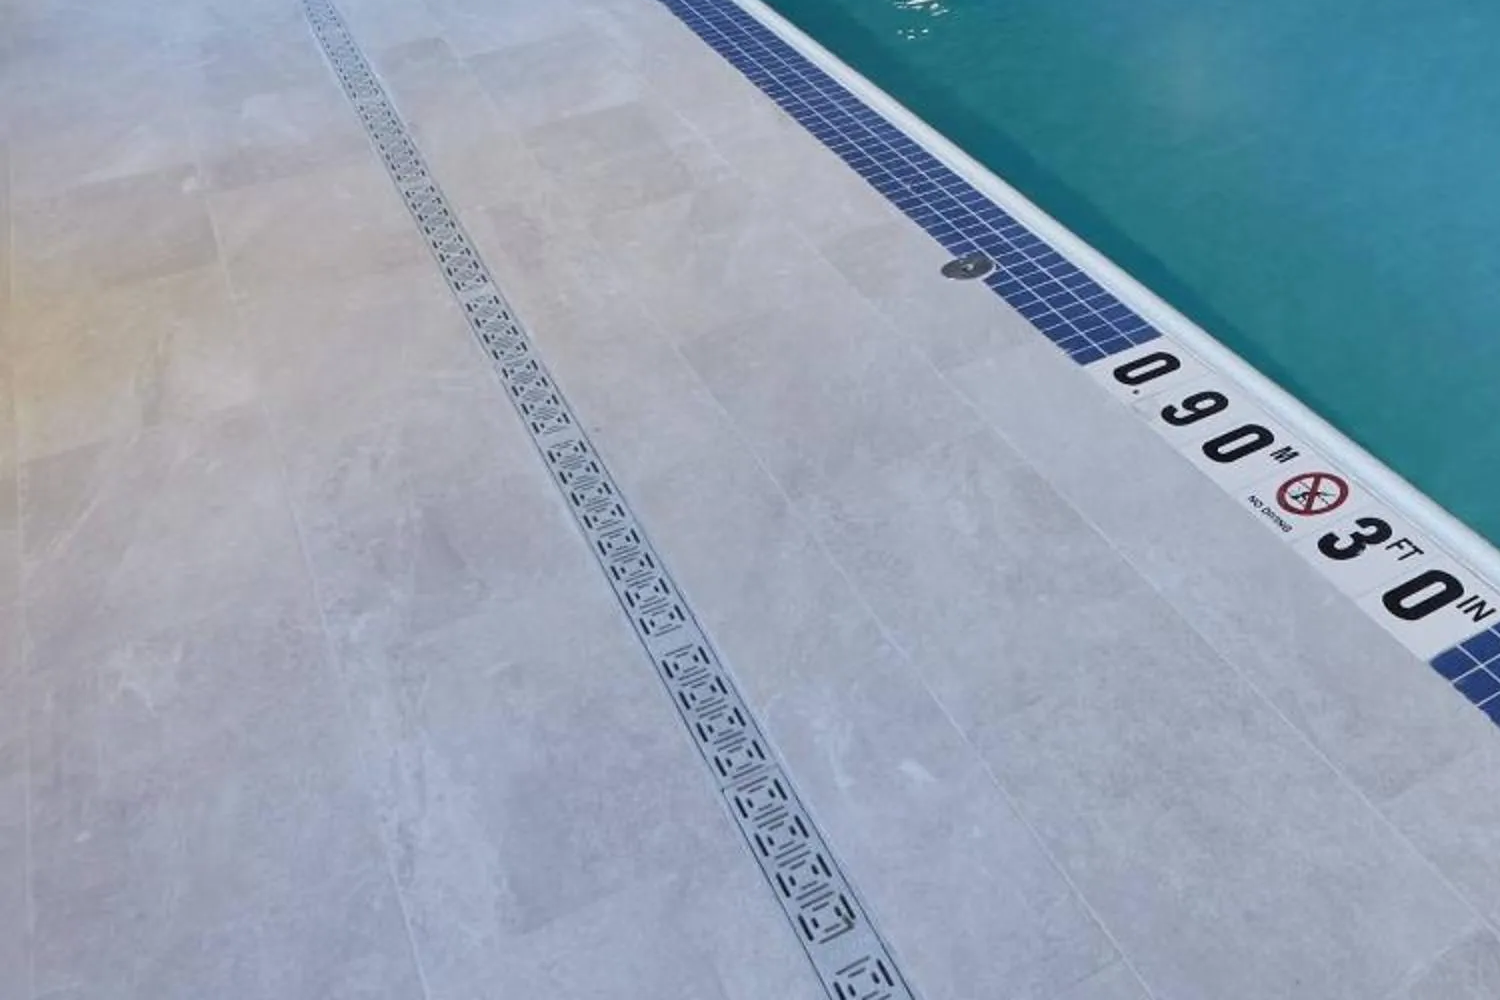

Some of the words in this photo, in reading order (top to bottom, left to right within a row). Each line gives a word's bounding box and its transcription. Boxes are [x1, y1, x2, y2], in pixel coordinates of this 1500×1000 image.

[1269, 445, 1300, 464] M
[1247, 495, 1263, 508] NO
[1261, 506, 1293, 533] DIVING
[1317, 517, 1393, 561] 3
[1385, 537, 1425, 562] FT
[1382, 569, 1465, 621] 0
[1456, 594, 1497, 623] IN
